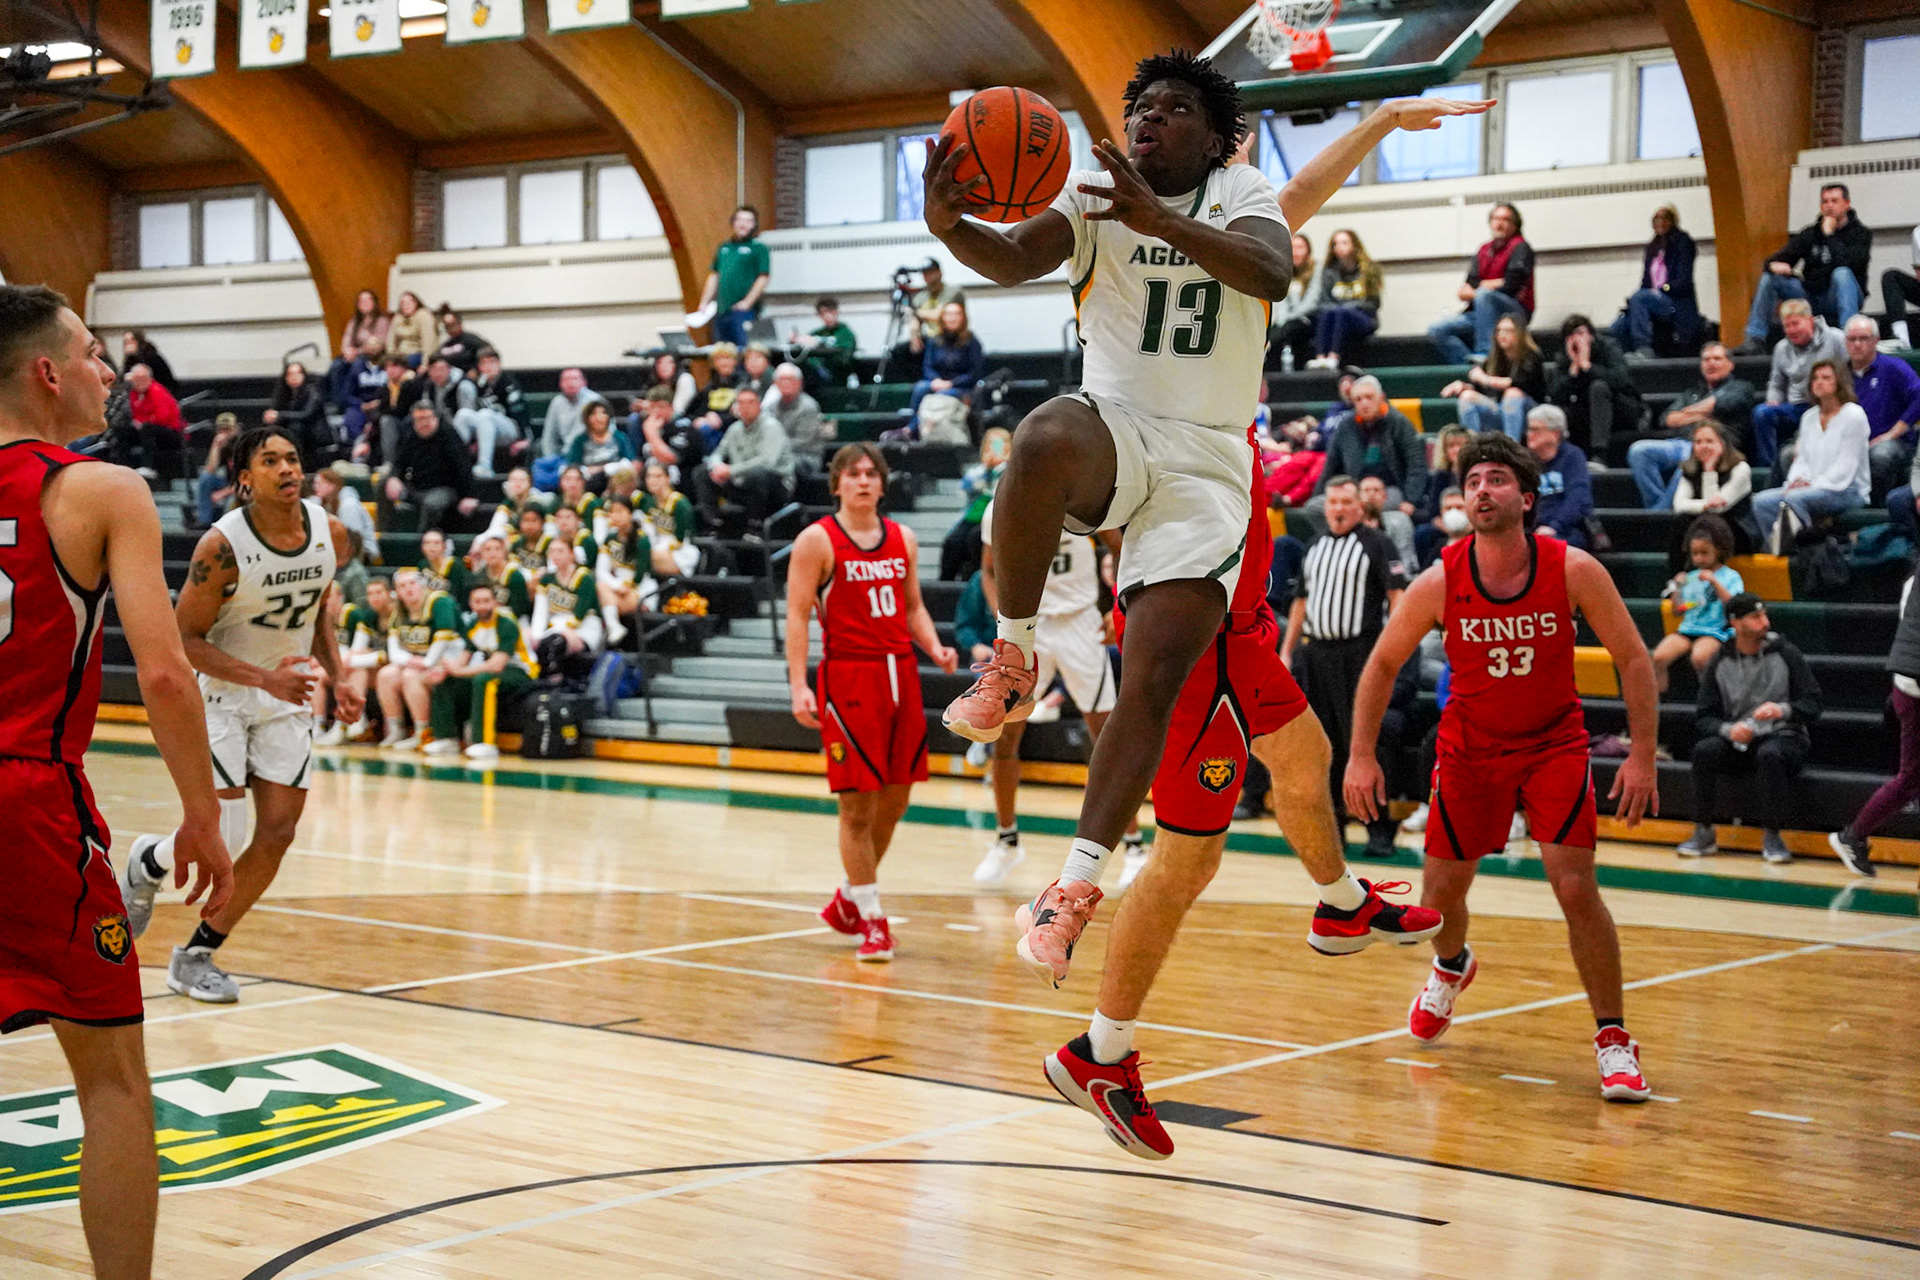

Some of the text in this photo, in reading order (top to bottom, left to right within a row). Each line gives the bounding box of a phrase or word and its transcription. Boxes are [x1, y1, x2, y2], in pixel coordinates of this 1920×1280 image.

[1129, 244, 1196, 266] AGG
[1138, 277, 1224, 358] 13
[261, 565, 323, 587] AGGIES
[843, 557, 906, 582] KING'S
[250, 587, 322, 630] 22
[867, 585, 897, 618] 10
[1459, 611, 1557, 643] KING'S
[1487, 646, 1535, 678] 33
